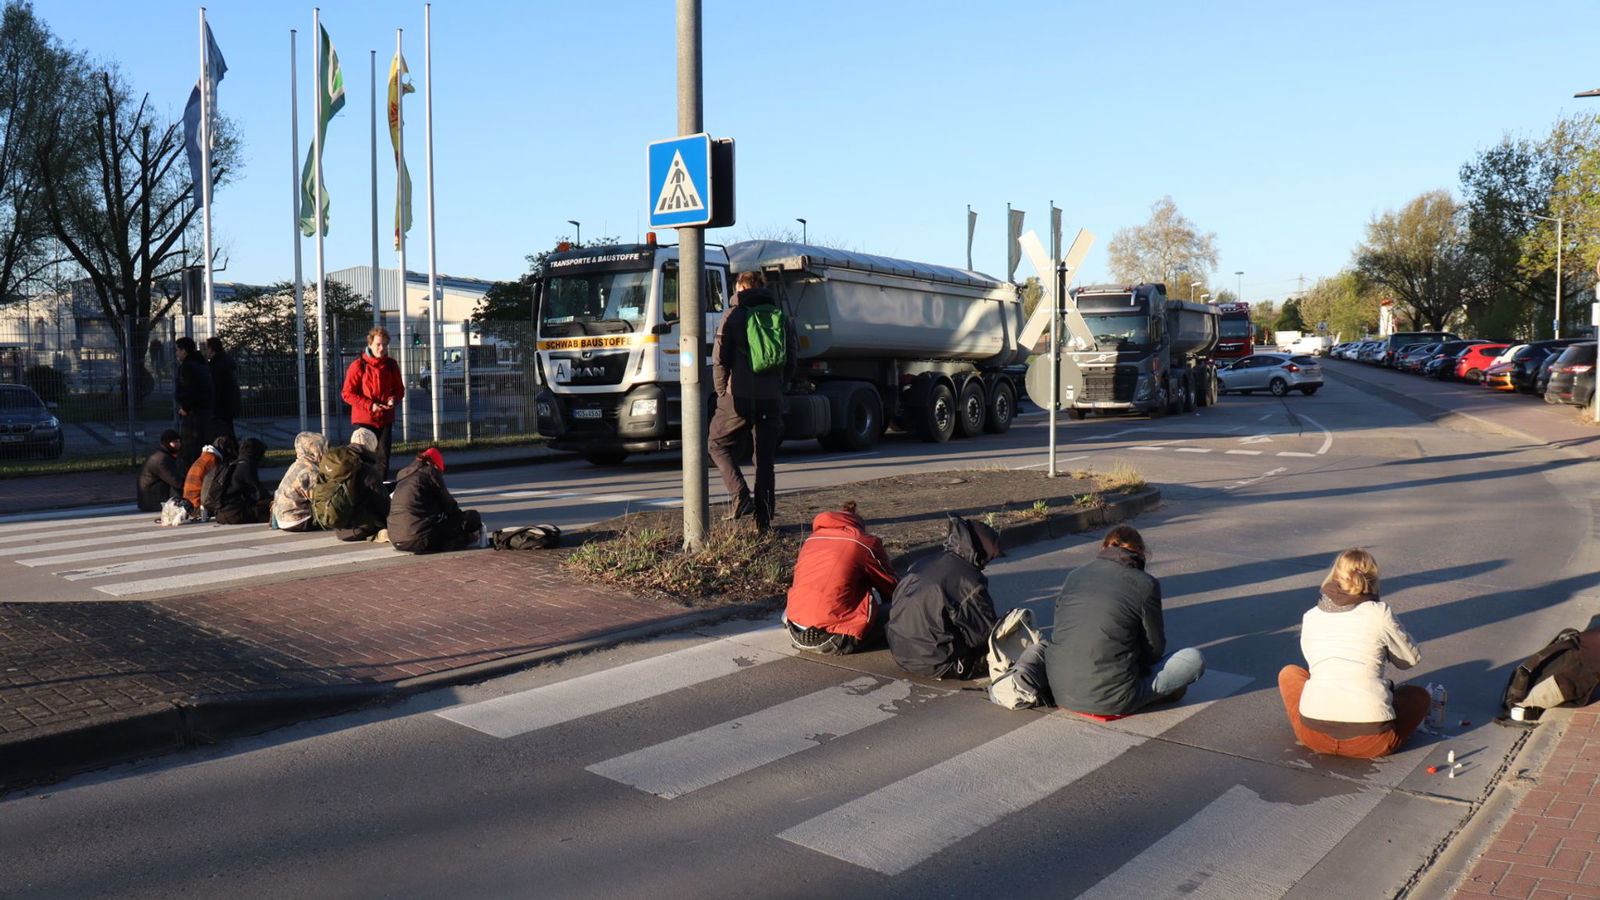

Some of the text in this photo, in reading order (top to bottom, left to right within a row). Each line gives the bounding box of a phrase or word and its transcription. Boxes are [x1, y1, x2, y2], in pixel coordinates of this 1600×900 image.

[550, 258, 591, 268] TRANSPORTE
[597, 253, 640, 262] BAUSTOFFE
[545, 337, 632, 350] SCHWAB BAUSTOFFE
[556, 363, 566, 379] A
